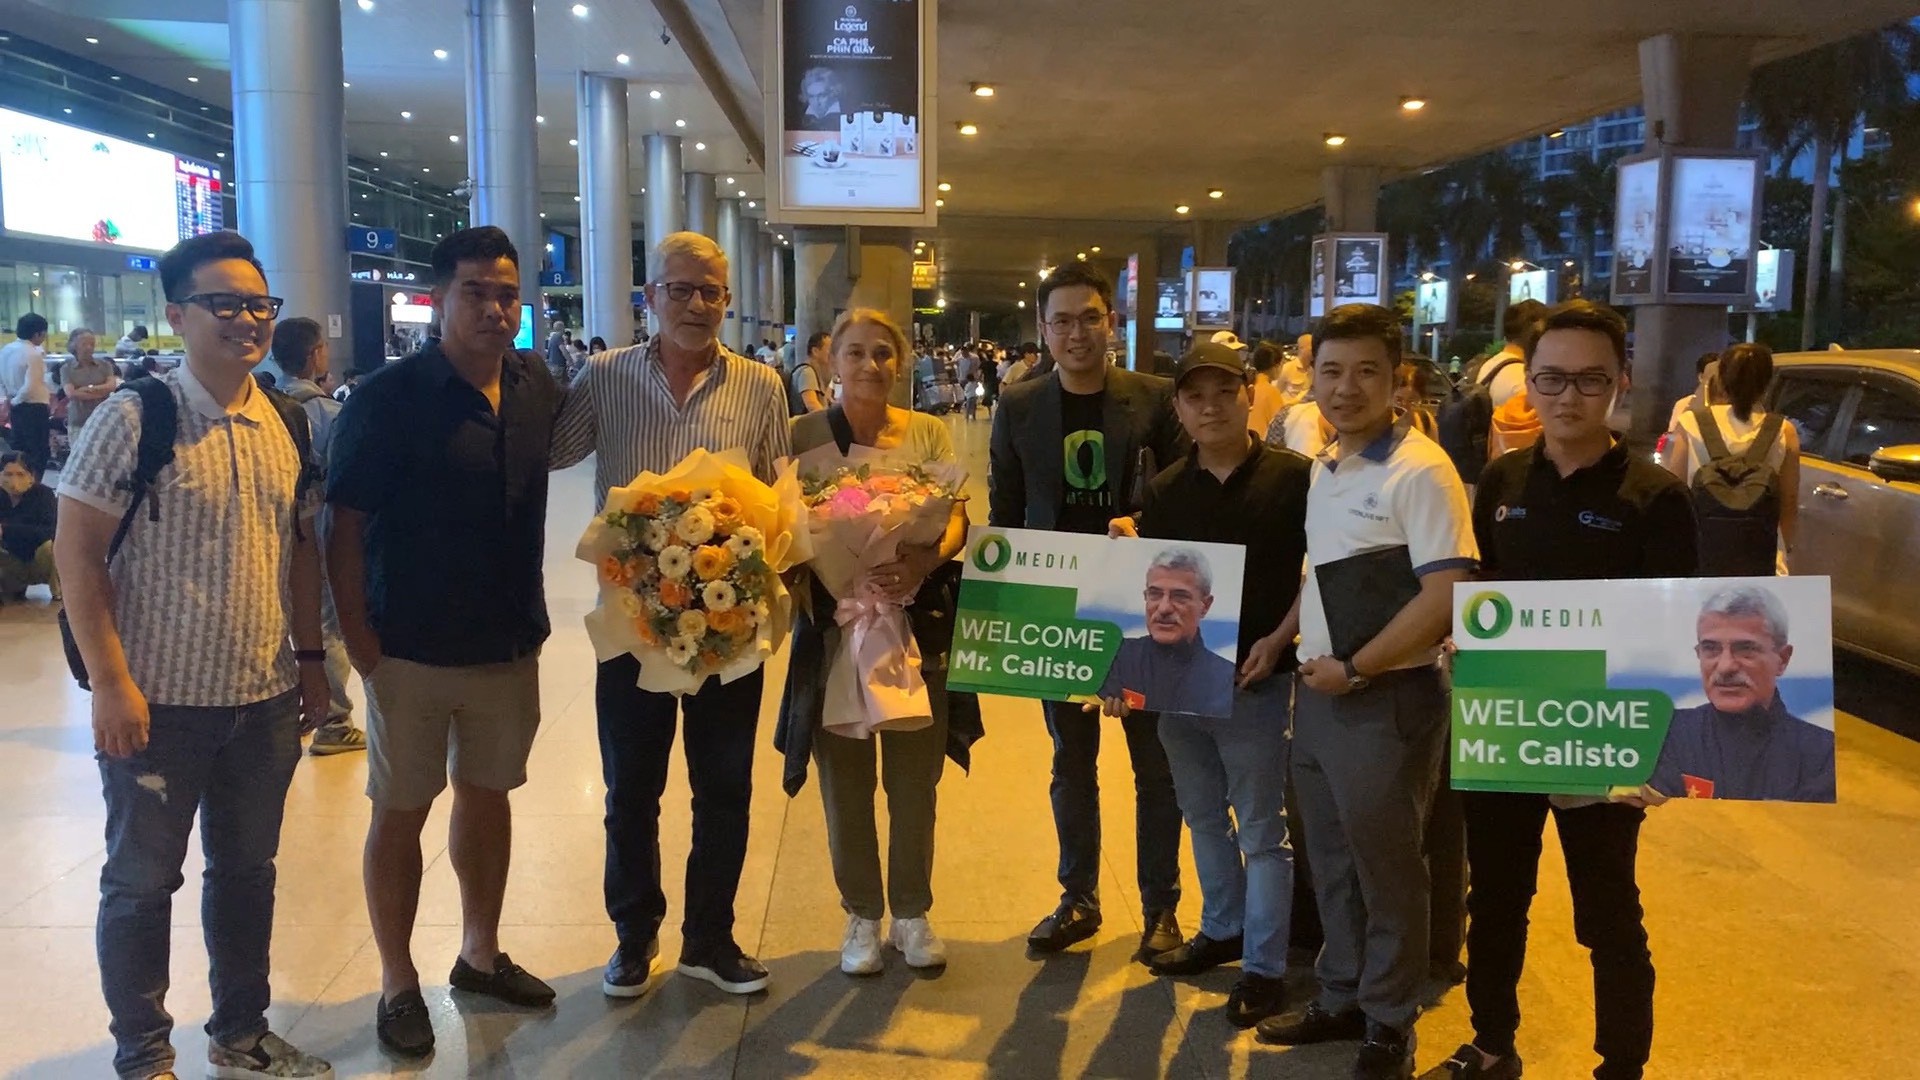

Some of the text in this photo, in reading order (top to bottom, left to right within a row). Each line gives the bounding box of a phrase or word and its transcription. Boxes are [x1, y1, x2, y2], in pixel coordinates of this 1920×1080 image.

[834, 20, 868, 33] Legend
[366, 231, 379, 249] 9
[553, 273, 562, 285] 8
[1016, 551, 1078, 571] MEDIA
[1520, 608, 1603, 628] MEDIA
[961, 617, 1105, 652] WELCOME
[955, 650, 1093, 682] Mr. Calisto
[1459, 698, 1650, 729] WELCOME
[1458, 738, 1640, 768] Mr. Calisto
